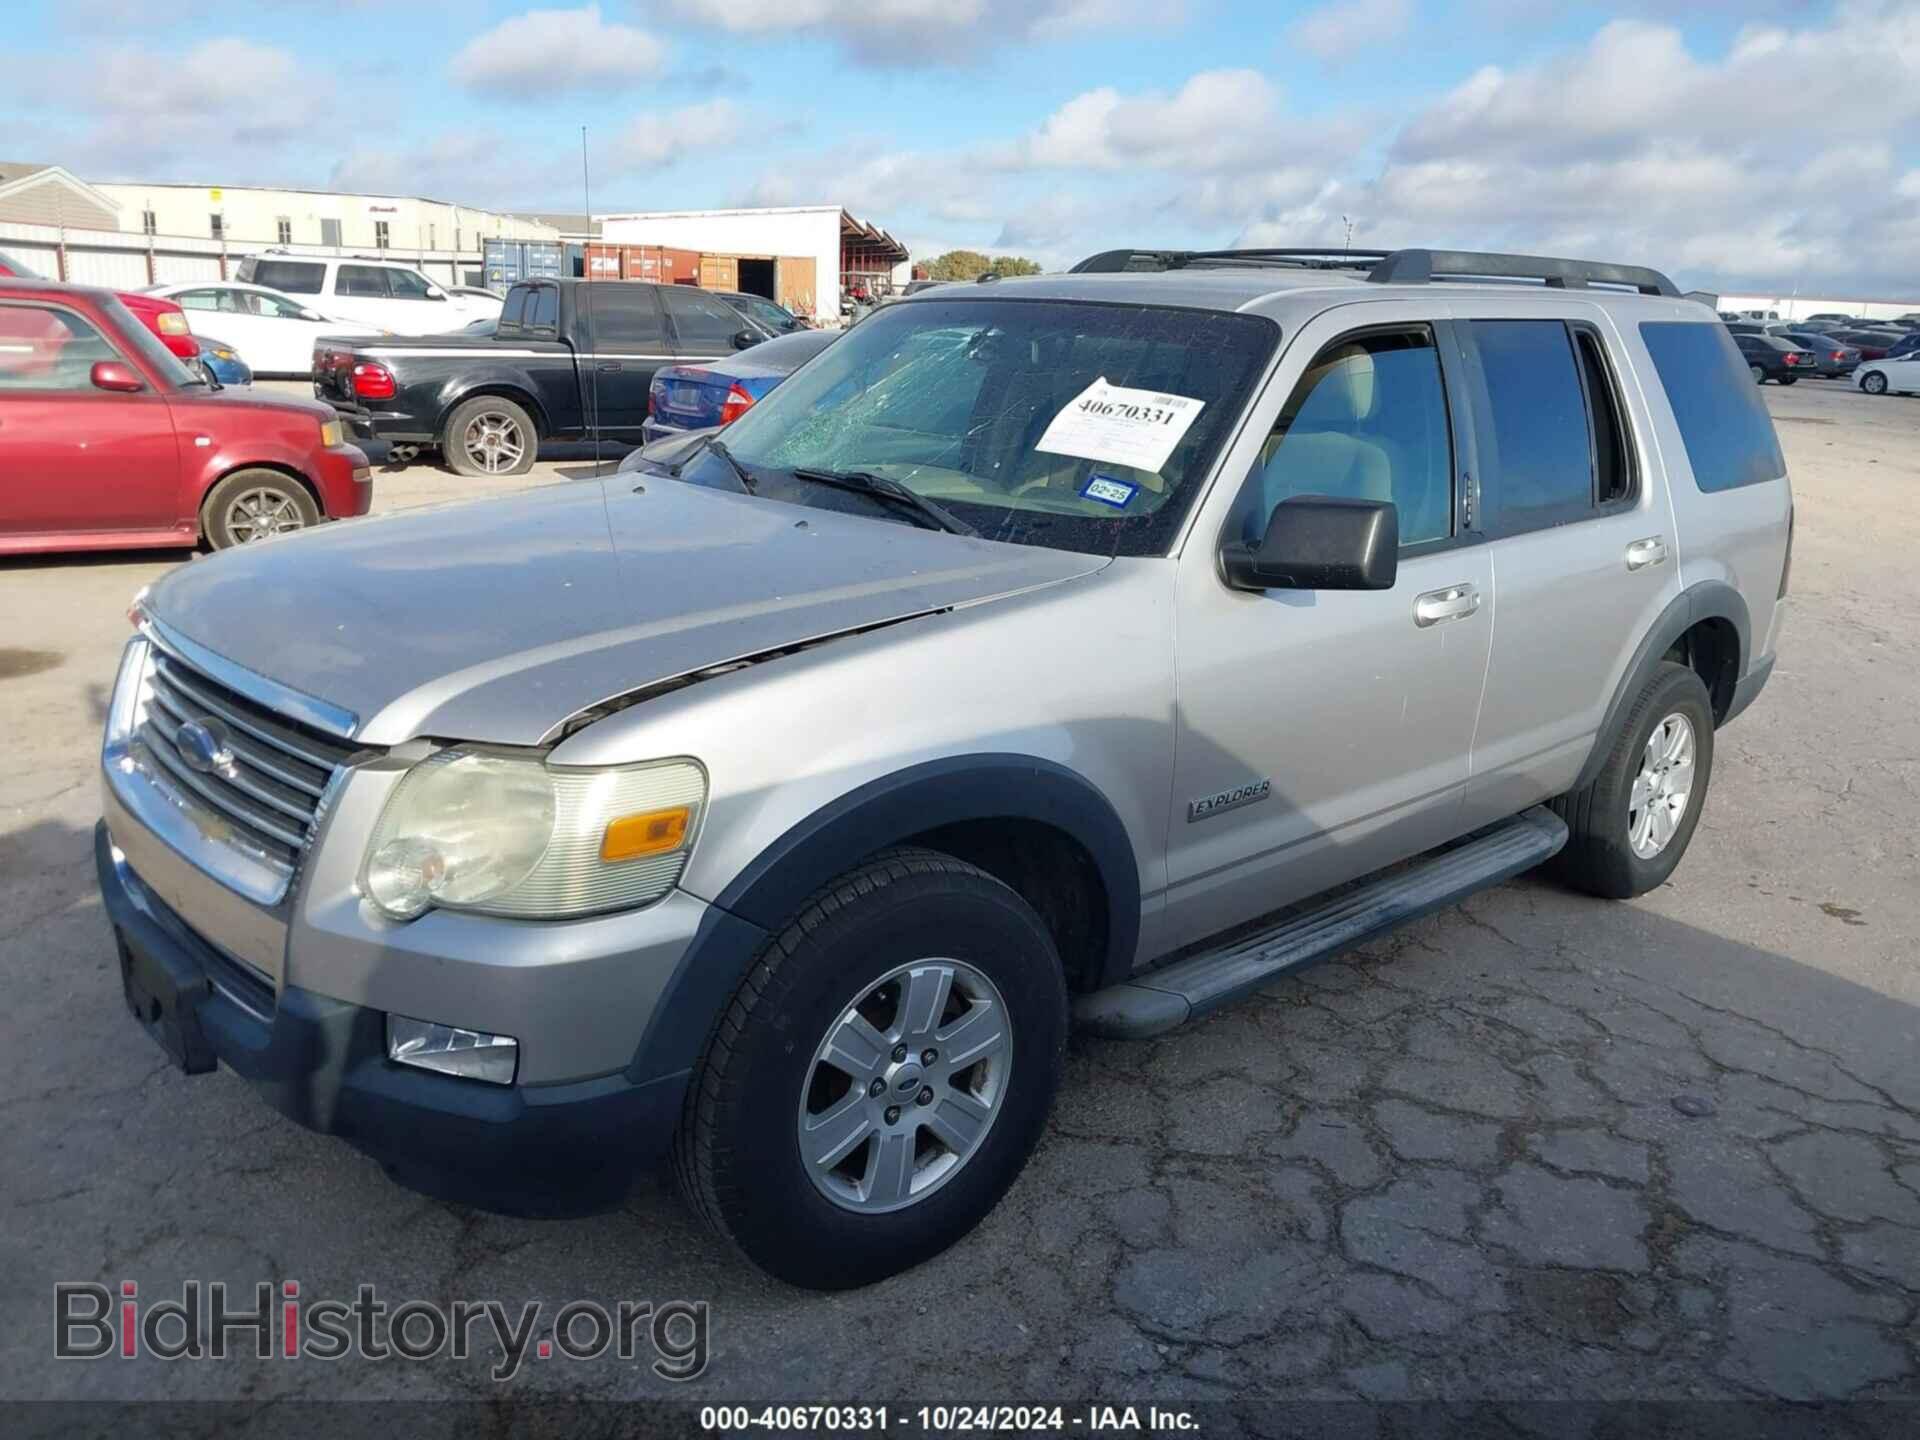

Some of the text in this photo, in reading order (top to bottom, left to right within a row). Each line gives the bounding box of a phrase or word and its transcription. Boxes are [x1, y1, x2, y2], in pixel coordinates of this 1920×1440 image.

[1079, 398, 1175, 426] 40670331
[1090, 483, 1127, 500] 02-25
[1194, 779, 1271, 814] EXPLORER
